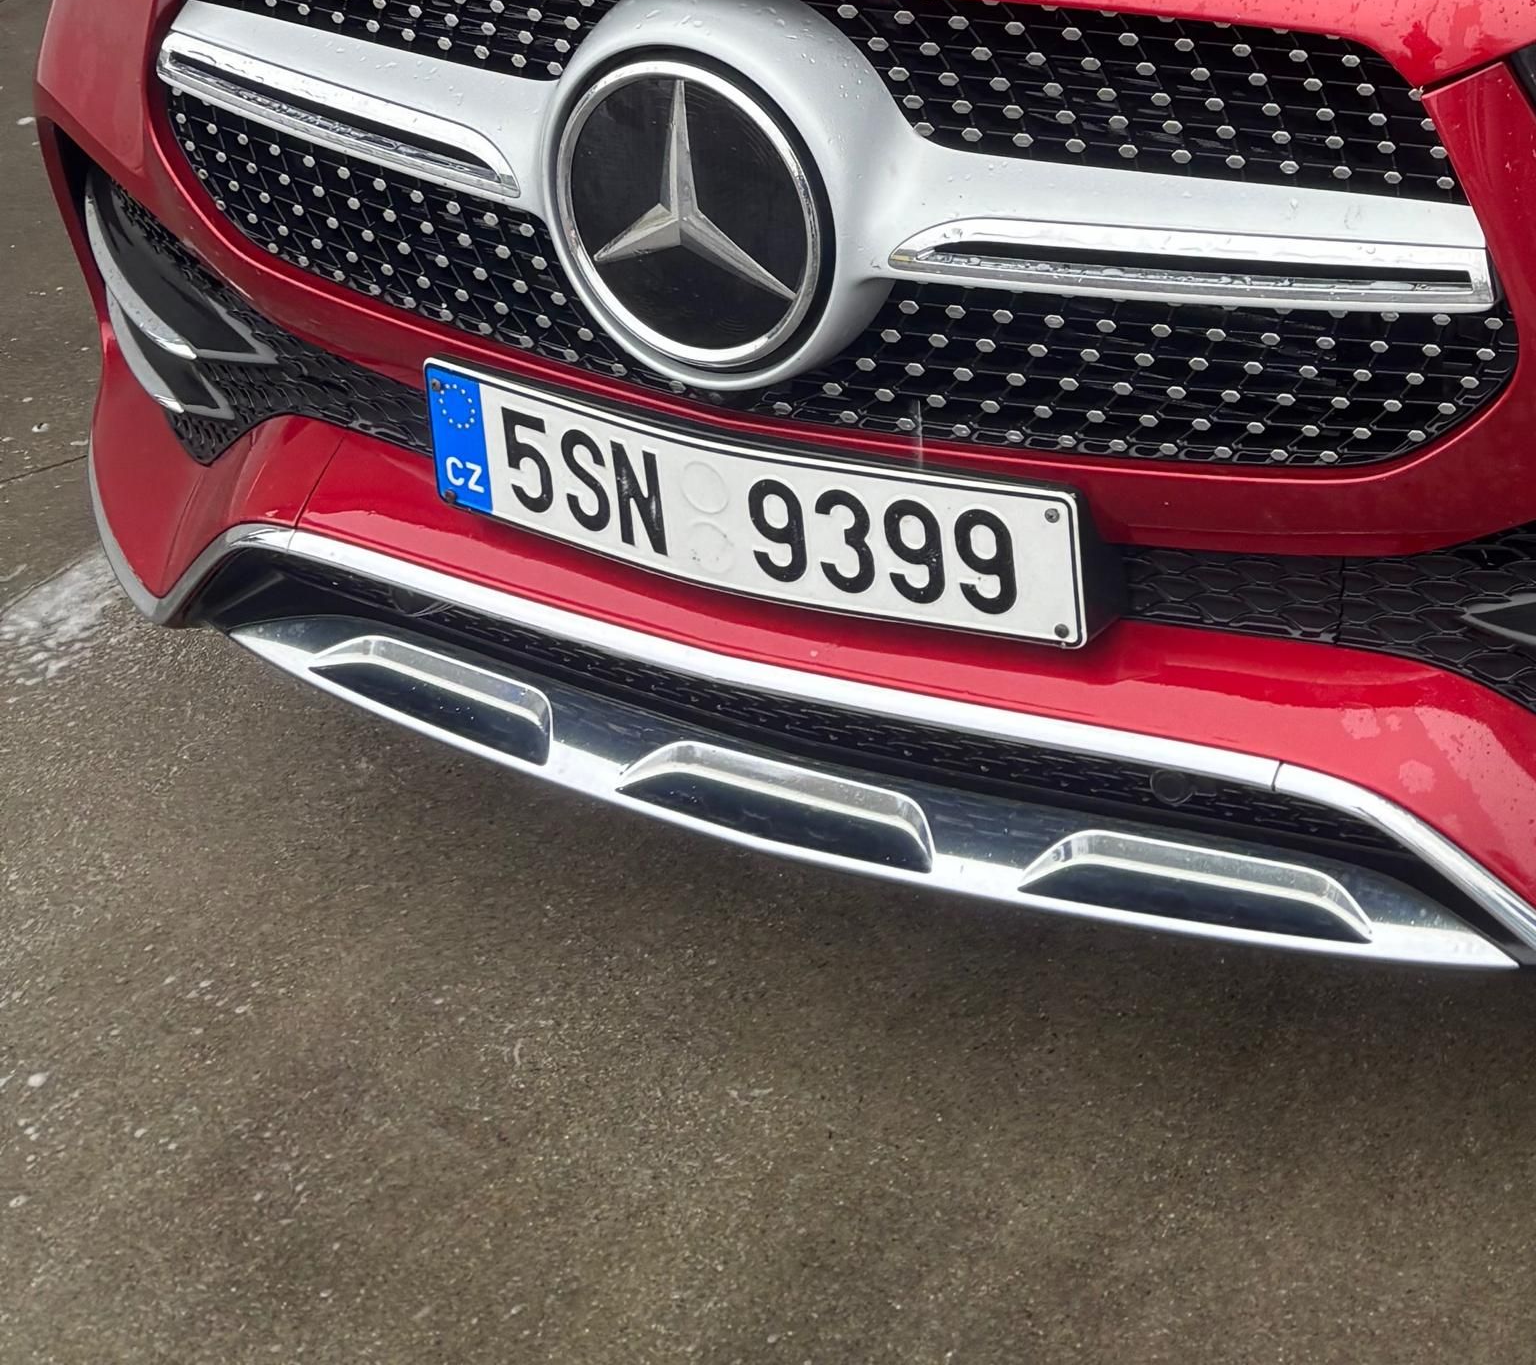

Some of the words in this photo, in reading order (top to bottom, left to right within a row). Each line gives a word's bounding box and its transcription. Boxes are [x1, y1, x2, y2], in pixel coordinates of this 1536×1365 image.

[445, 456, 484, 494] CZ
[500, 405, 669, 557] 5SN
[747, 479, 1018, 616] 9399
